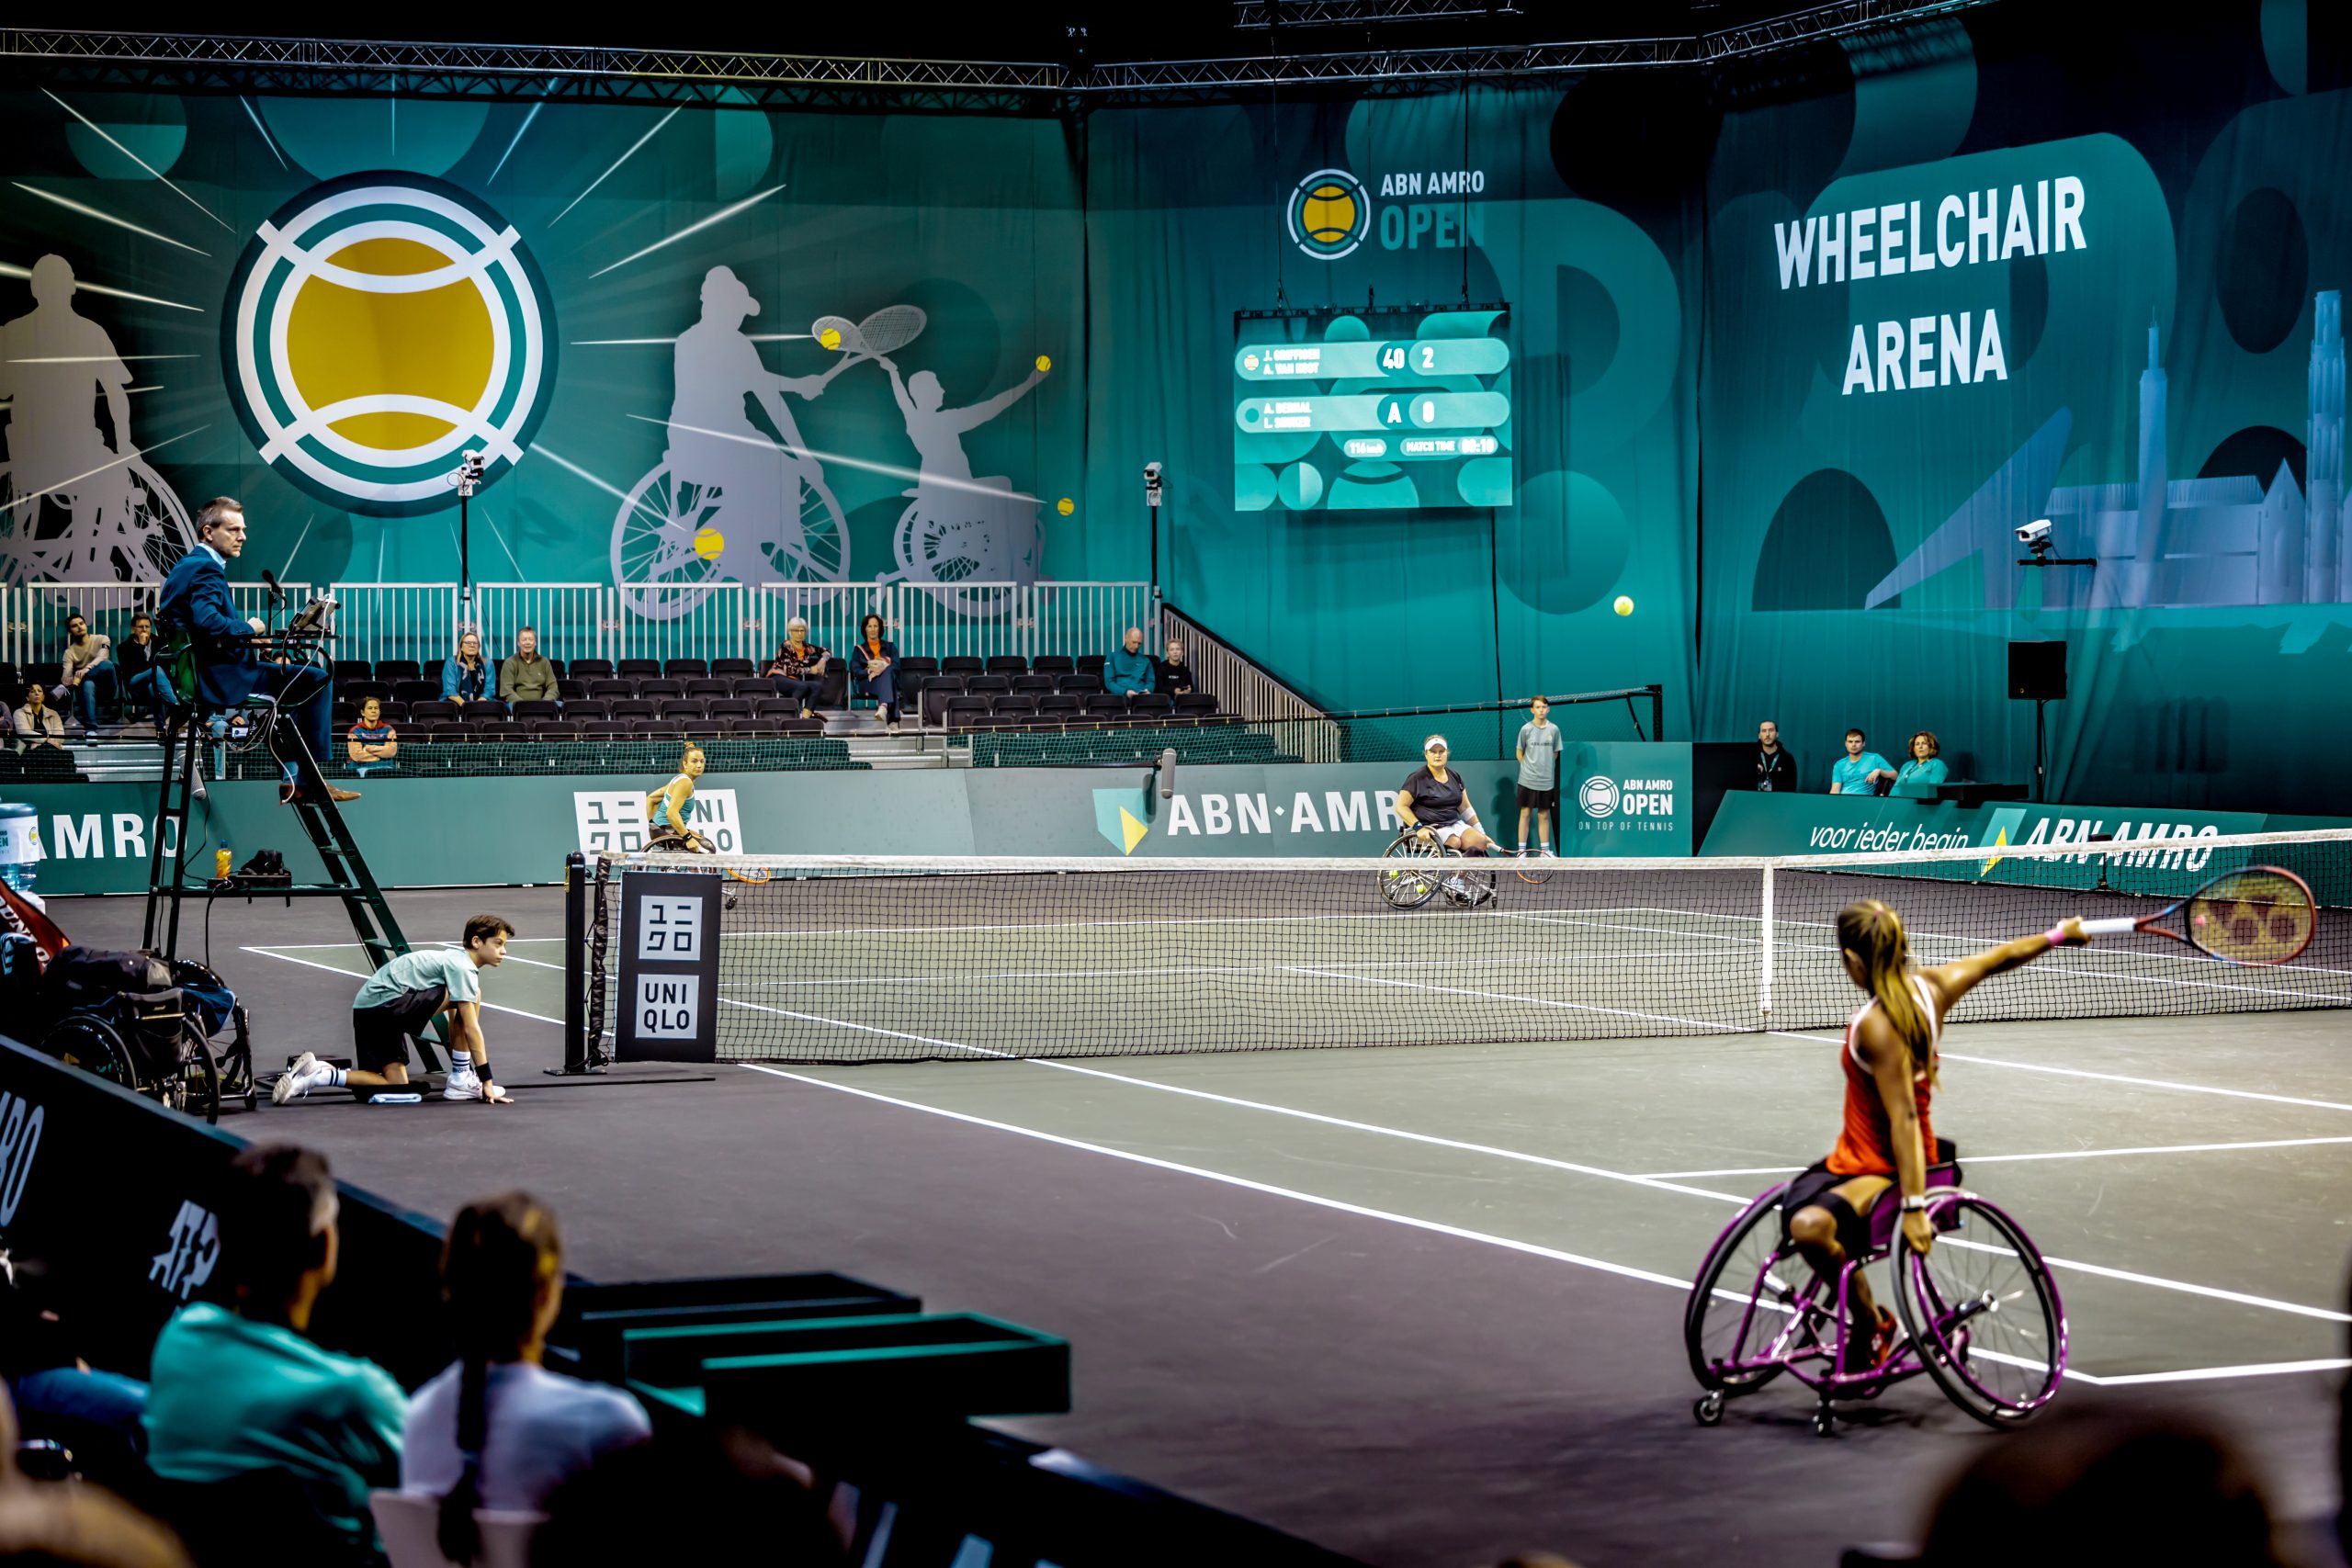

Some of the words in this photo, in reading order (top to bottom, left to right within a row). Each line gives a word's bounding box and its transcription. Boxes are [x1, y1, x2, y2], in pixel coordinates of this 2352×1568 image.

[1381, 173, 1421, 197] ABN
[1427, 170, 1485, 194] AMRO
[1380, 201, 1486, 251] OPEN
[1774, 175, 2087, 290] WHEELCHAIR
[1383, 347, 1405, 369] 40
[1422, 346, 1434, 368] 2
[1842, 309, 2007, 395] ARENA
[1386, 401, 1402, 423] A
[1406, 442, 1434, 452] MATCH
[1434, 440, 1455, 451] TIME
[1623, 779, 1644, 791] ABN
[1645, 779, 1673, 791] AMRO
[695, 799, 725, 823] NI
[1623, 794, 1673, 816] OPEN
[1578, 821, 1590, 830] ON
[1597, 821, 1614, 830] TOP
[1620, 821, 1631, 830] OF
[1638, 821, 1673, 831] TENNIS
[1810, 826, 1856, 848] voor
[1854, 821, 1910, 852] ieder
[644, 983, 686, 1004] UNI
[643, 1009, 689, 1033] QLO
